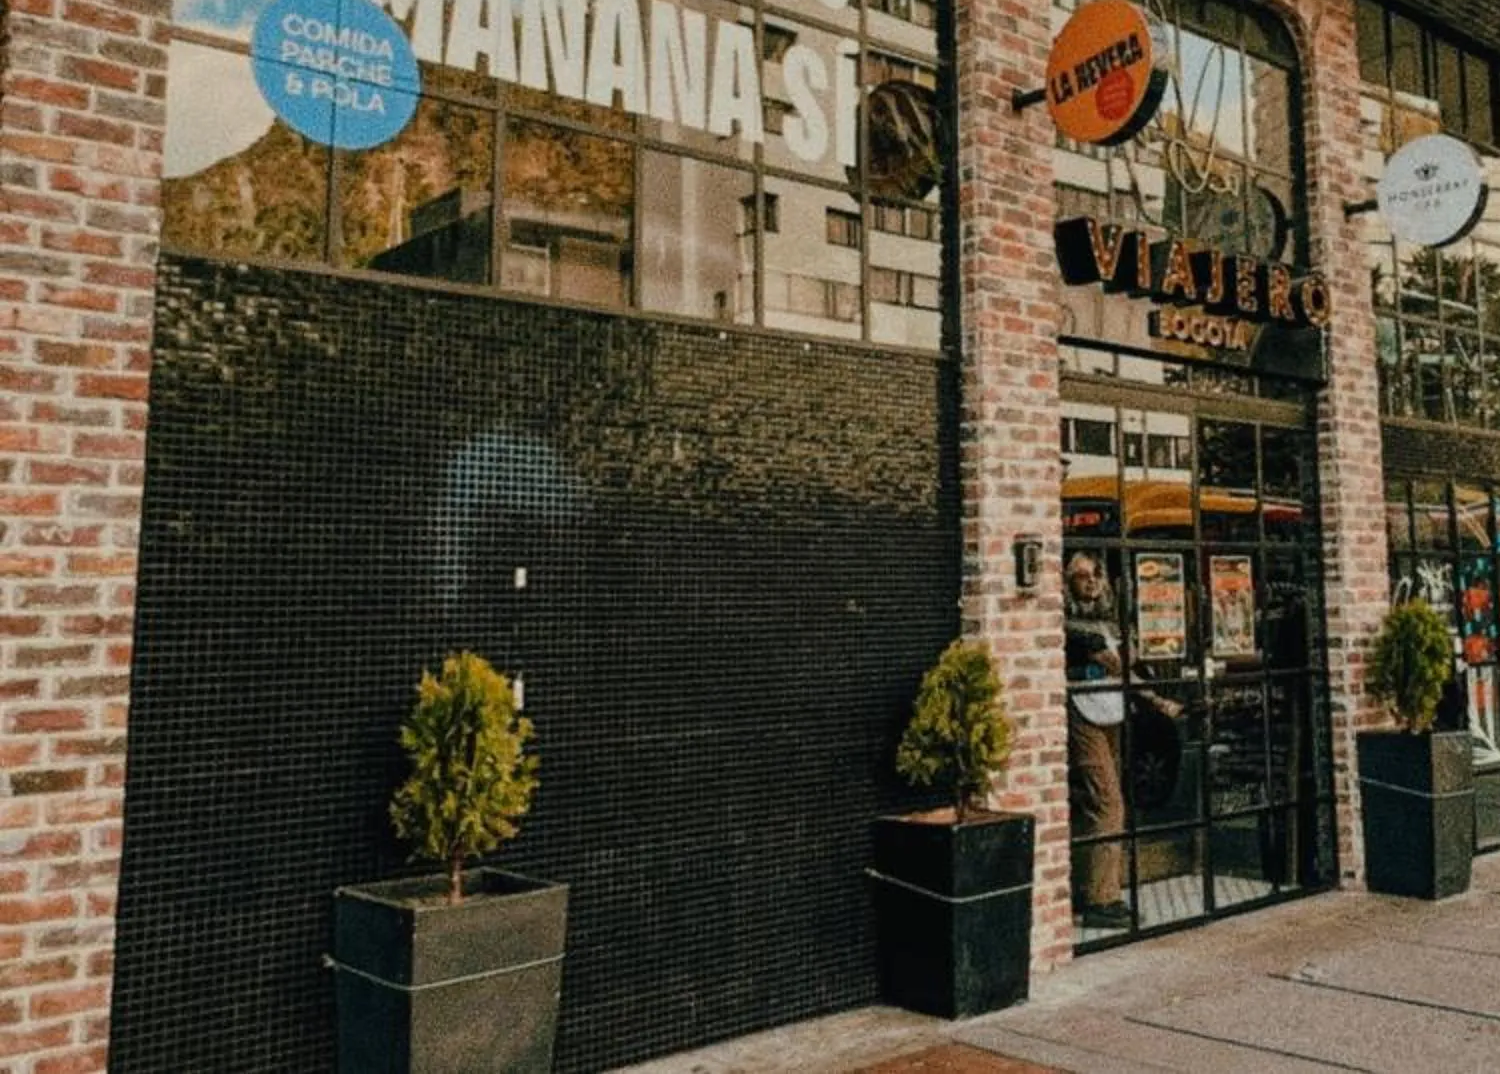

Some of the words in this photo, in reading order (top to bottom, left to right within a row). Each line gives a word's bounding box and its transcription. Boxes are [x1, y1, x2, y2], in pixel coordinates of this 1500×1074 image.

[281, 12, 394, 62] COMIDA
[281, 38, 393, 87] PARCHE
[311, 76, 386, 115] POLA
[1051, 71, 1075, 105] LA
[1085, 216, 1331, 327] VIAJERO
